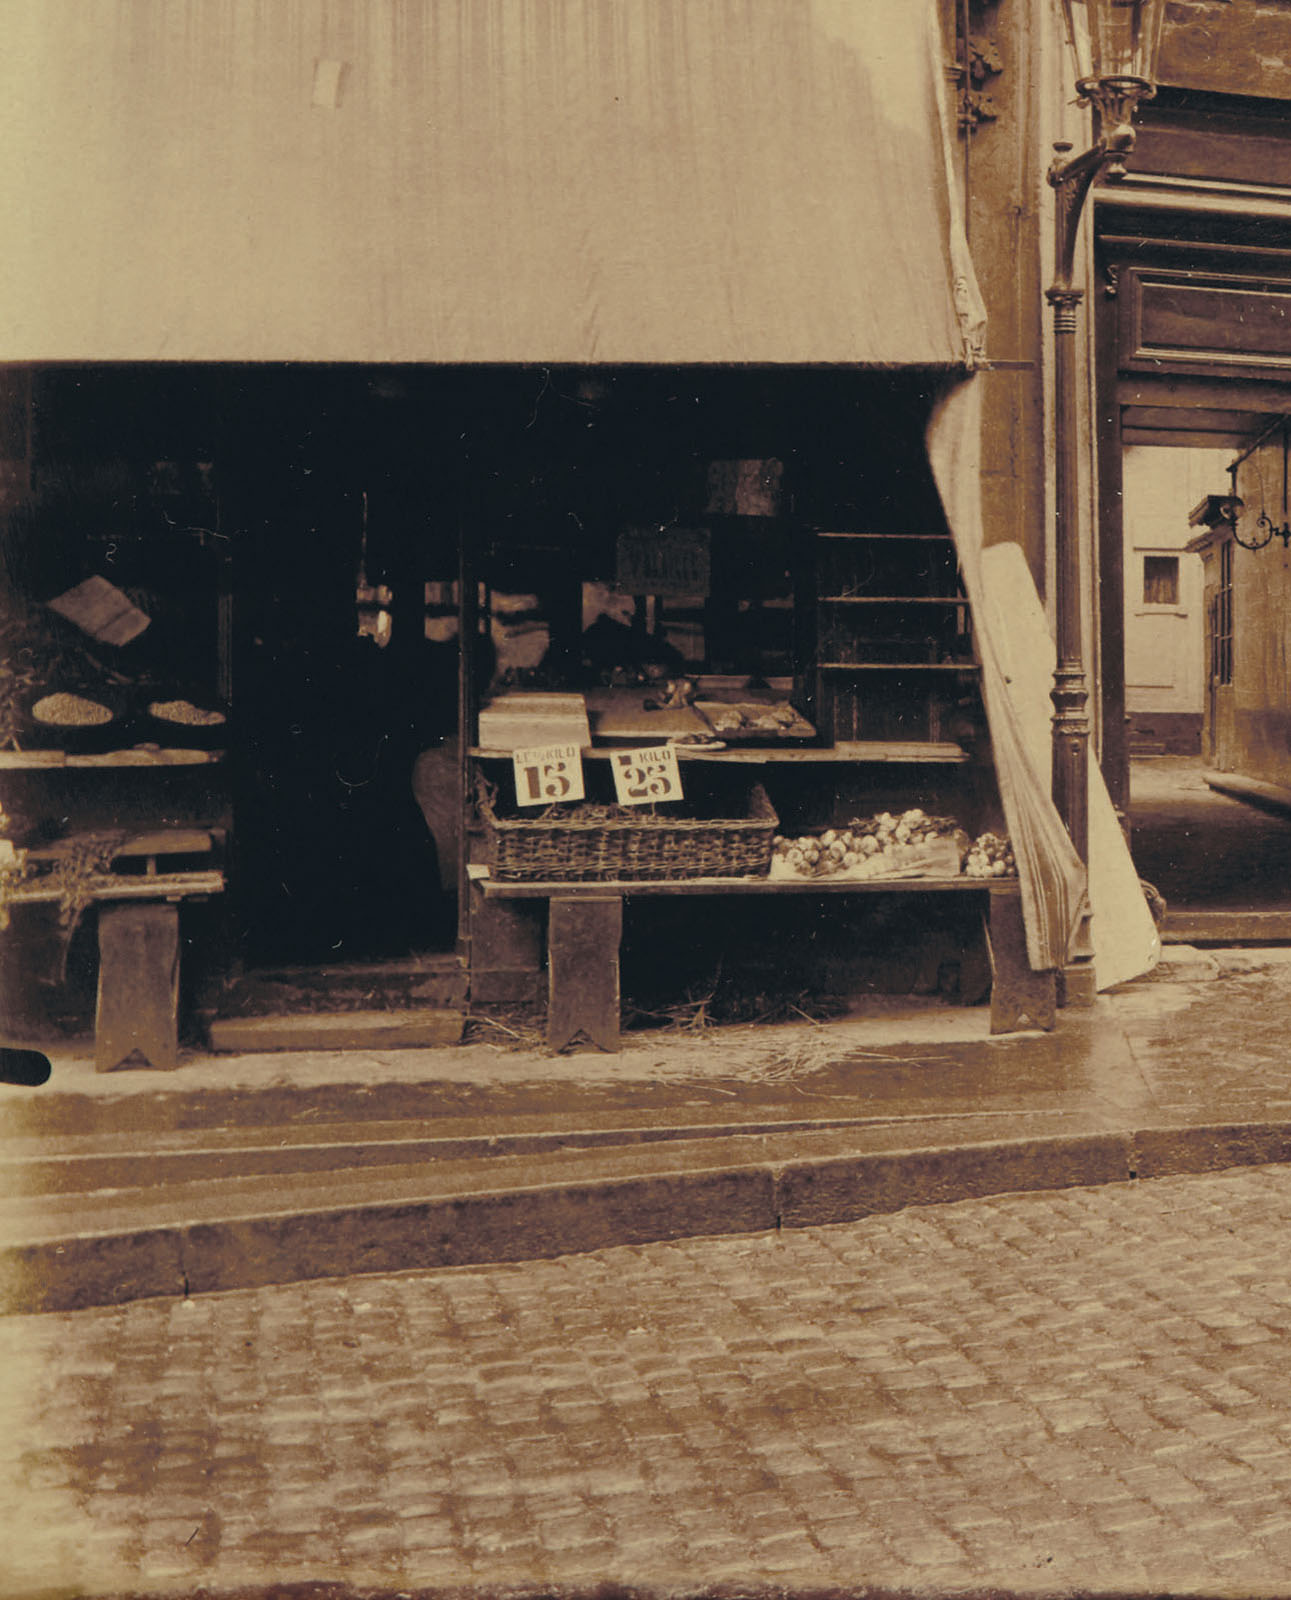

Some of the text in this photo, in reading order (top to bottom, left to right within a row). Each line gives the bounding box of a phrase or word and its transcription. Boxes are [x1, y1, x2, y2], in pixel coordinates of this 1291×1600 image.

[546, 746, 576, 760] KILO
[639, 750, 671, 764] KILO
[524, 761, 571, 799] 15
[624, 764, 672, 798] 25
